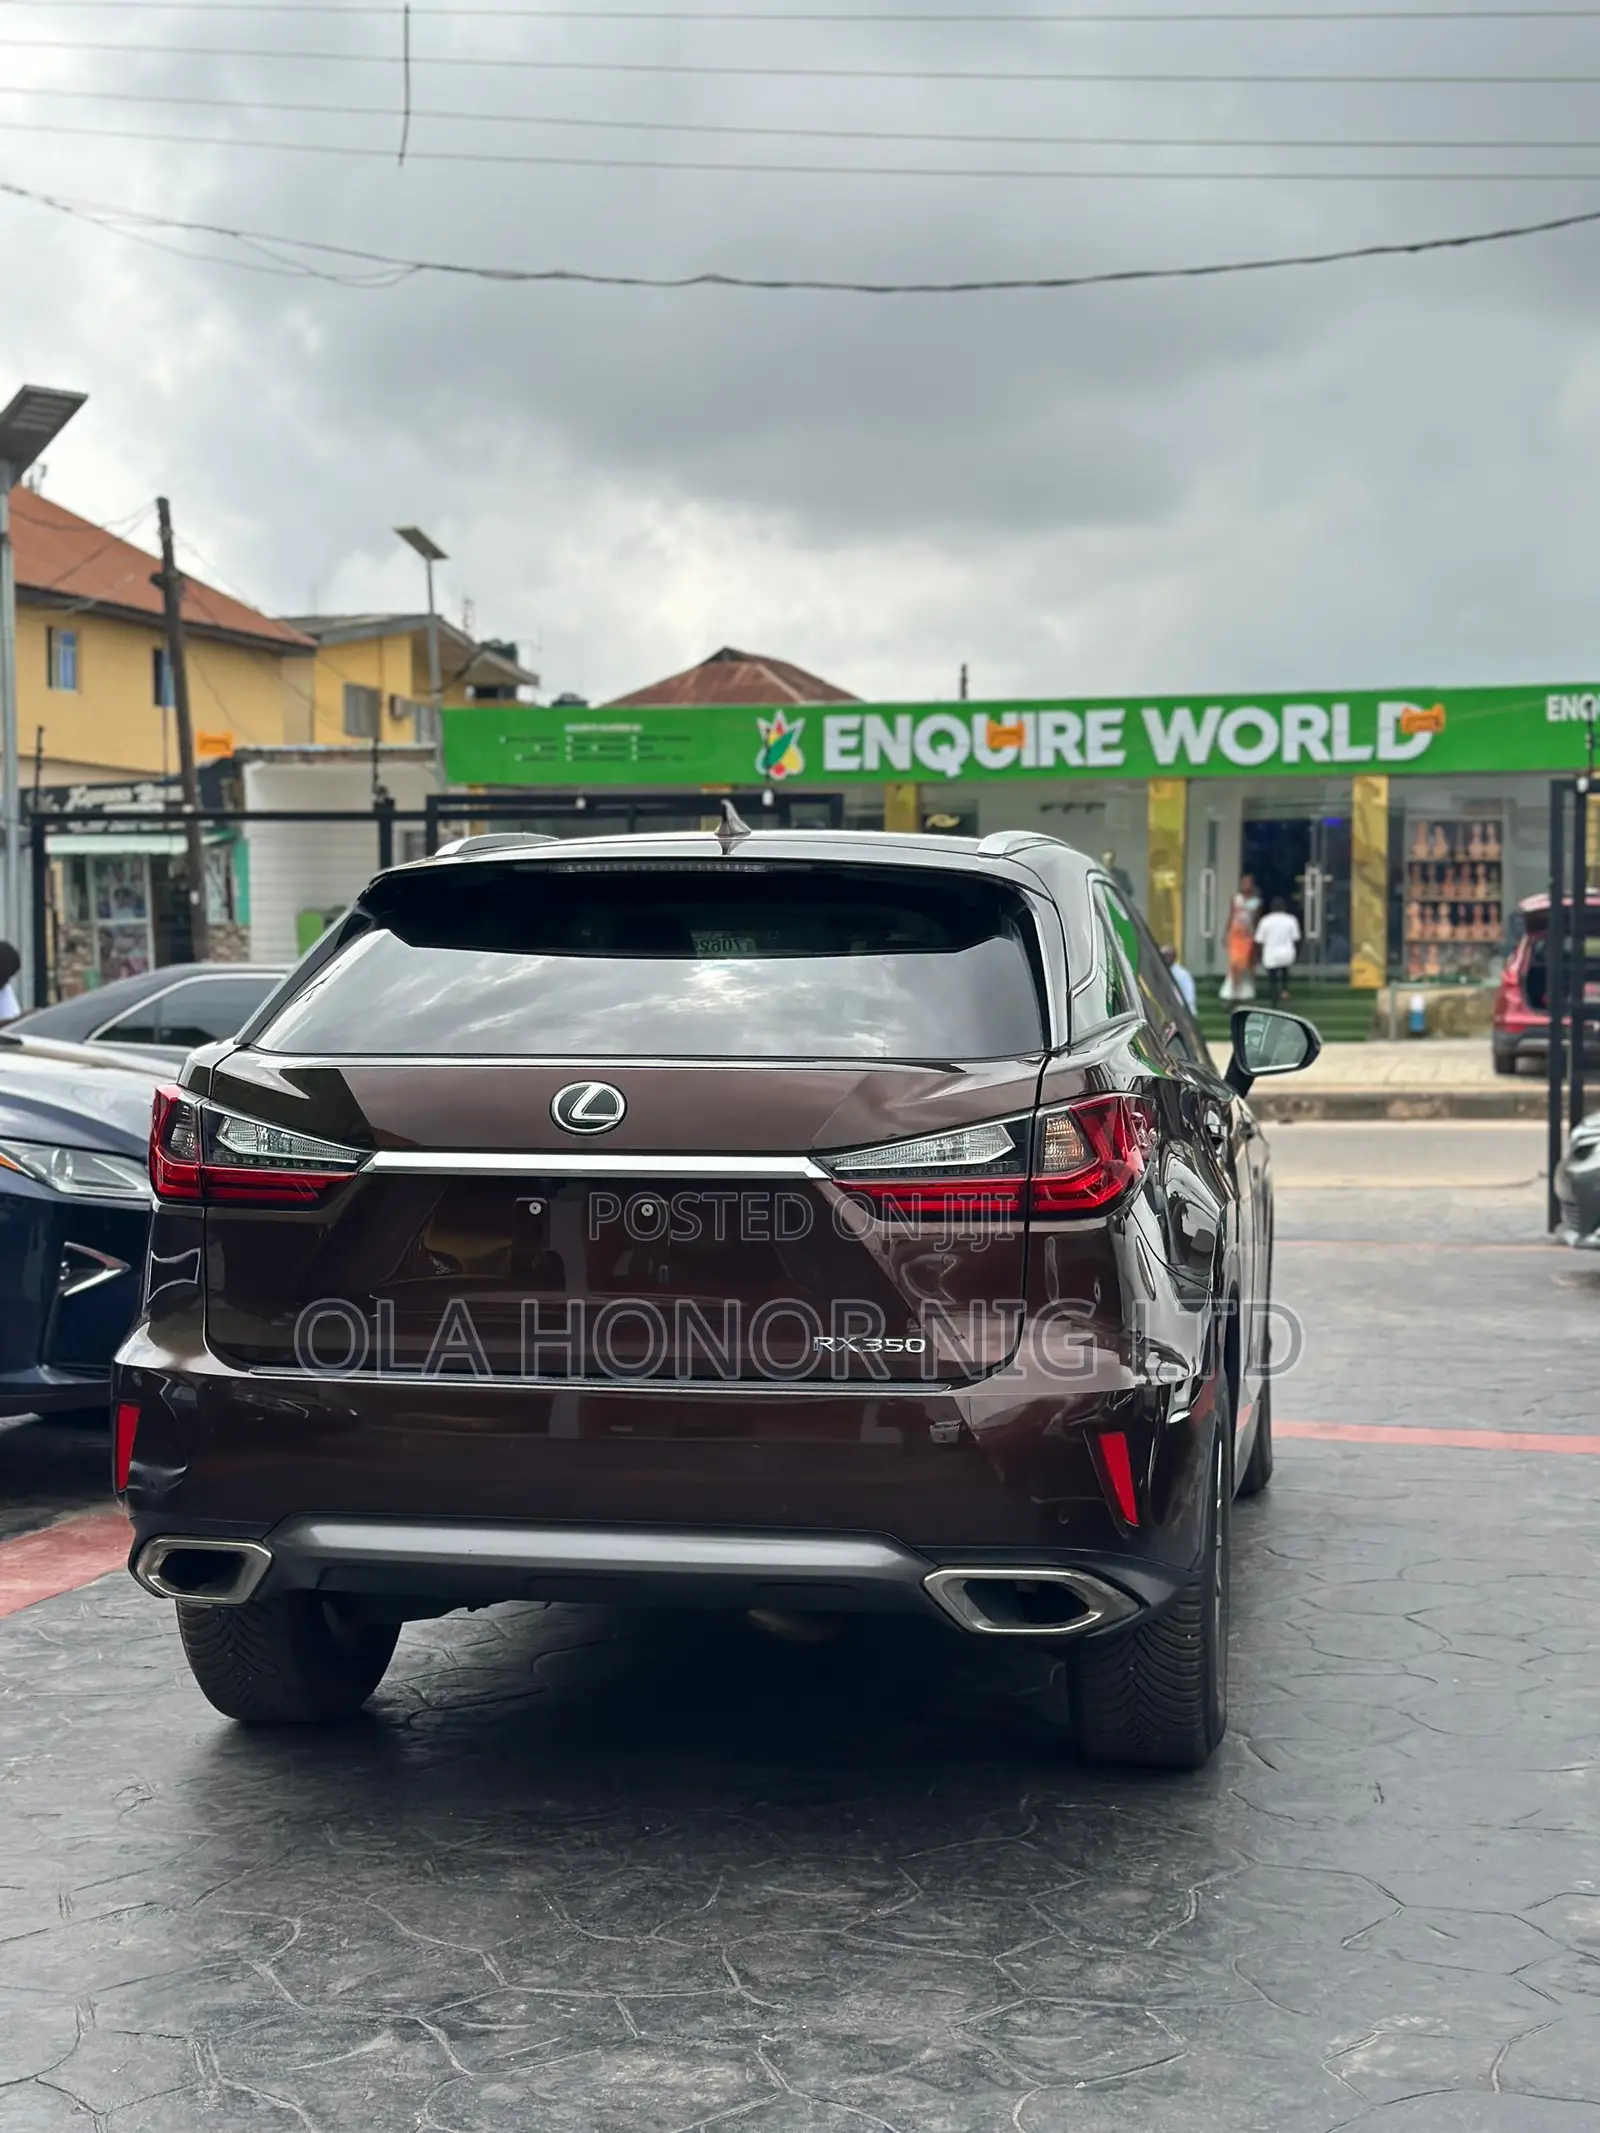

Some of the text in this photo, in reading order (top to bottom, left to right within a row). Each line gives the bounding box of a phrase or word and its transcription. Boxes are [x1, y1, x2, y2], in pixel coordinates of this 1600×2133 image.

[1546, 693, 1600, 723] ENQ
[823, 702, 1433, 779] ENQUIRE WORLD
[813, 1335, 926, 1354] RX 350
